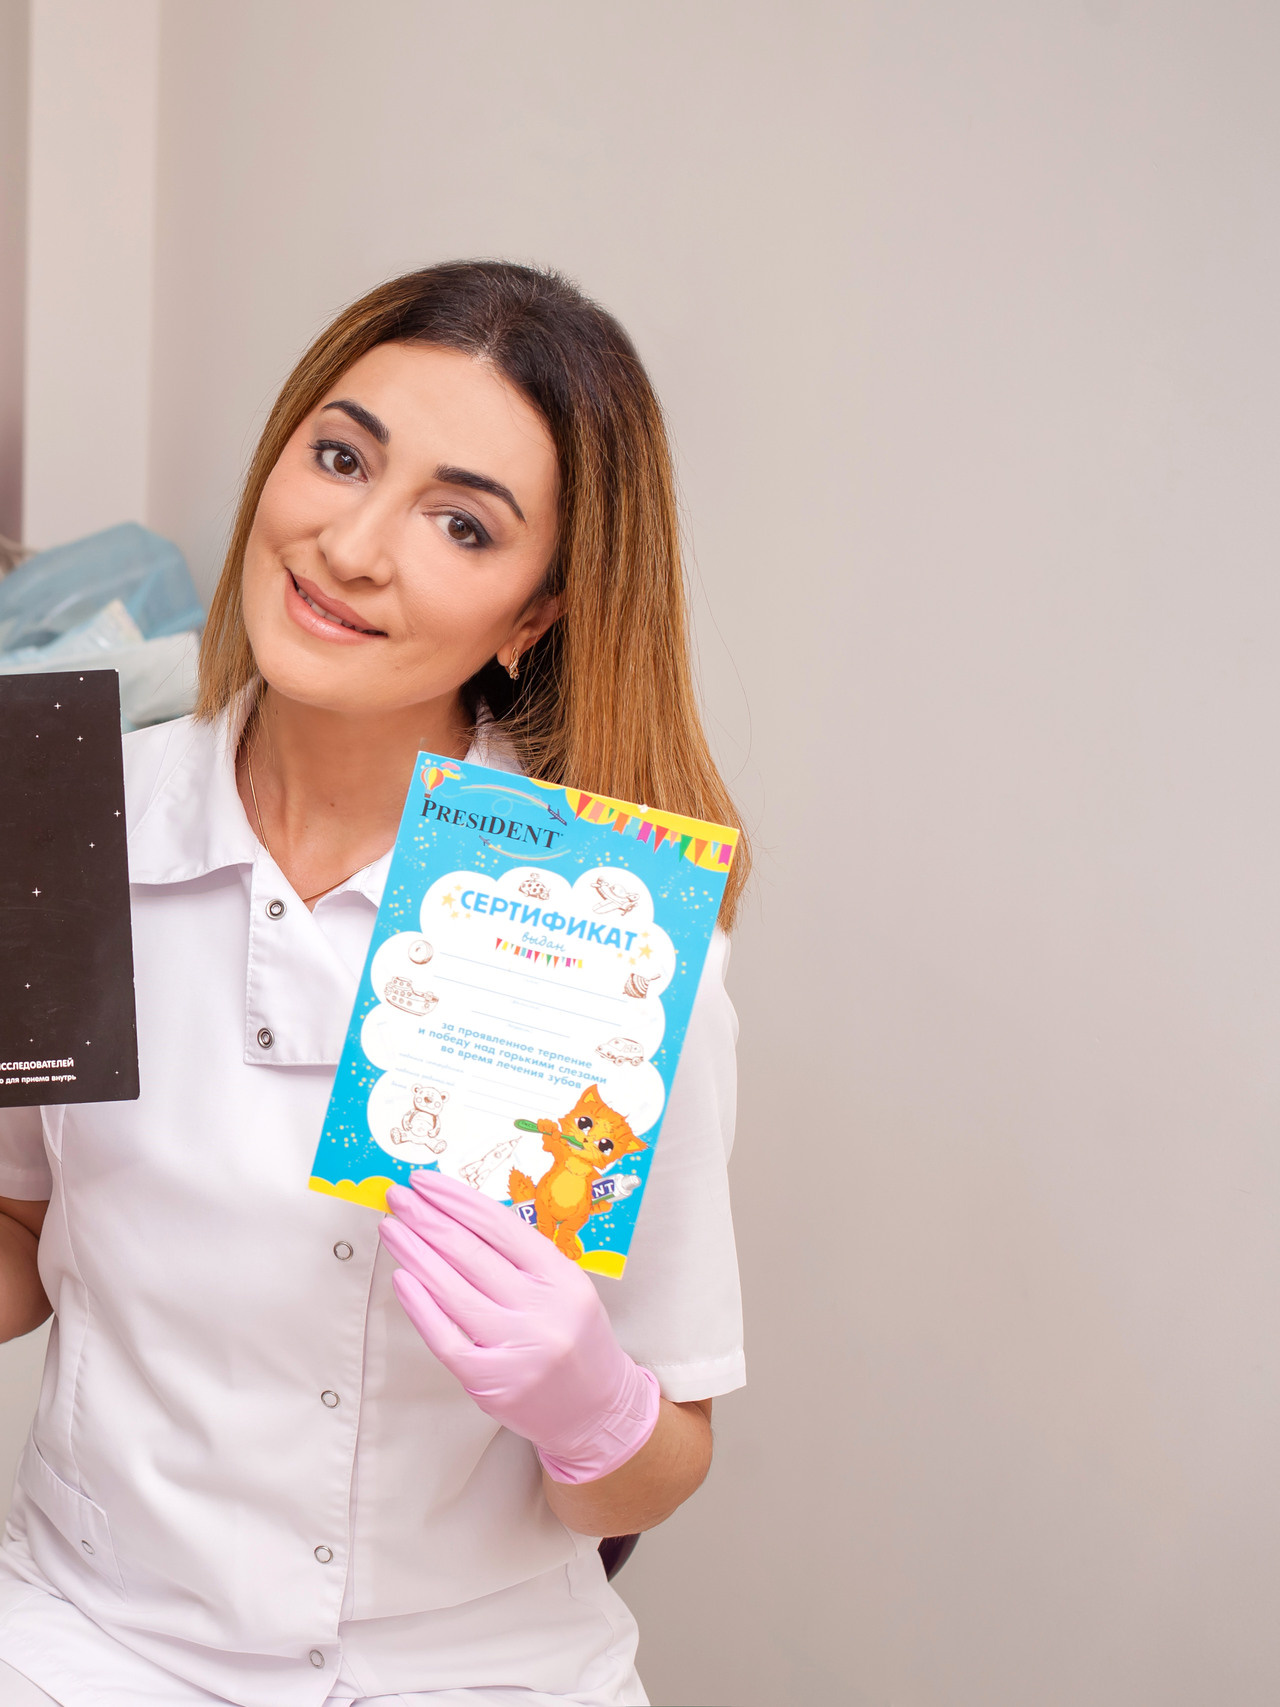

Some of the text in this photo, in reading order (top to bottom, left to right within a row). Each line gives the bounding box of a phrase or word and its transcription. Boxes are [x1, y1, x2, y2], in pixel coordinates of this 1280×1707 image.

[420, 799, 560, 849] PRESIDENT
[460, 890, 638, 951] СЕРТИФИКАТ
[521, 931, 566, 952] выдан
[429, 1030, 470, 1049] победу
[474, 1043, 496, 1055] над
[499, 1049, 555, 1070] горькими
[558, 1065, 607, 1084] слезами
[441, 1022, 455, 1031] за
[458, 1027, 534, 1053] проявленное
[538, 1048, 592, 1069] терпение
[441, 1044, 454, 1054] во
[458, 1050, 493, 1065] время
[496, 1060, 544, 1079] лечения
[548, 1074, 582, 1089] зубов
[5, 1076, 20, 1085] для
[21, 1075, 49, 1084] приема
[52, 1074, 76, 1084] внутрь
